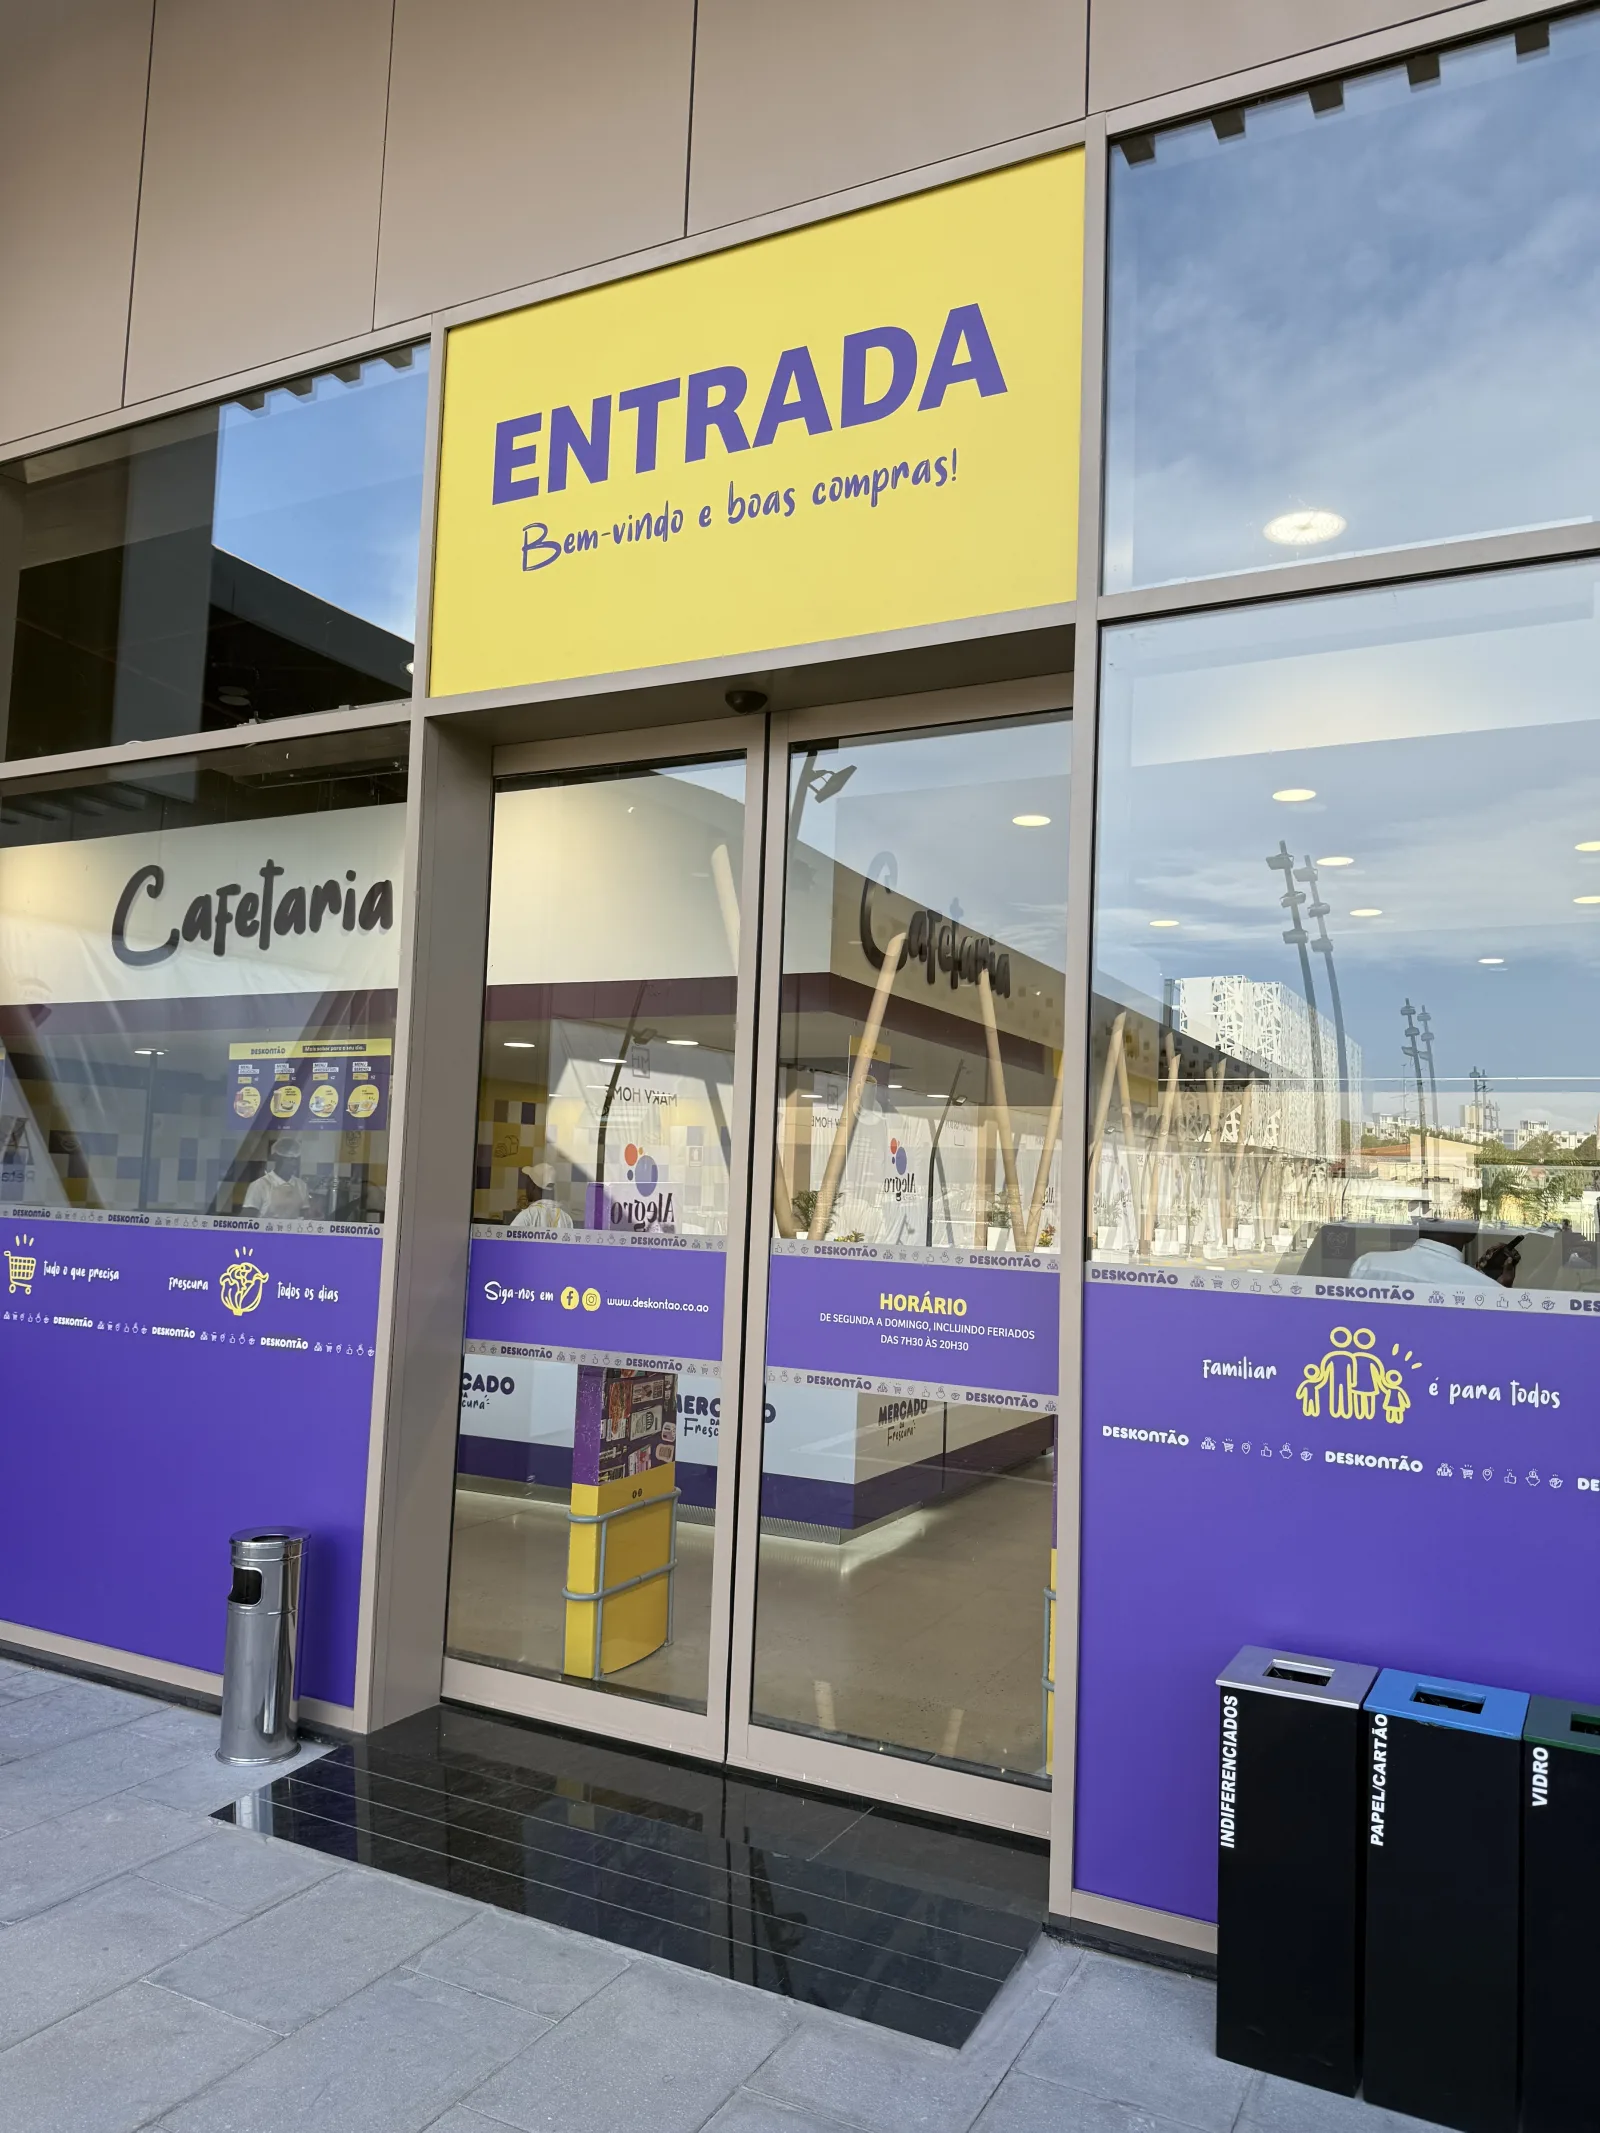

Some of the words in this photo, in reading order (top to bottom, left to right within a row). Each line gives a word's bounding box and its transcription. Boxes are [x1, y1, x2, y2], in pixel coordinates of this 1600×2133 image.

[492, 303, 1008, 505] ENTRADA
[522, 499, 684, 571] Bem-vindo
[698, 504, 712, 528] e
[727, 480, 796, 525] boas
[812, 447, 958, 508] compras!
[111, 859, 393, 966] Cafetaria
[860, 851, 1011, 998] Cafetaria
[12, 1208, 51, 1219] DESKONTÃO
[108, 1213, 150, 1225] DESKONTÃO
[213, 1218, 260, 1231] DESKONTÃO
[330, 1223, 382, 1236] DESKONTÃO
[506, 1229, 558, 1241] DESKONTÃO
[630, 1235, 687, 1248] DESKONTÃO
[813, 1245, 878, 1258] DESKONTÃO
[969, 1254, 1041, 1268] DESKONTÃO
[43, 1260, 60, 1276] Tudo
[62, 1266, 68, 1276] o
[70, 1266, 86, 1280] que
[88, 1266, 120, 1282] precisa
[1091, 1267, 1179, 1287] DESKONTÃO
[168, 1277, 209, 1292] Frescura
[277, 1281, 301, 1300] Todos
[304, 1287, 315, 1300] os
[318, 1284, 339, 1302] dias
[1315, 1284, 1415, 1302] DESKONTÃO
[484, 1280, 535, 1305] Siga-nos
[540, 1292, 554, 1302] em
[607, 1296, 709, 1313] www.deskontao.co.ao
[879, 1291, 968, 1317] HORÁRIO
[53, 1316, 93, 1329] DESKONTÃO
[819, 1313, 832, 1323] DE
[832, 1314, 875, 1327] SEGUNDA
[876, 1316, 883, 1327] A
[884, 1317, 932, 1332] DOMINGO,
[933, 1322, 985, 1336] INCLUINDO
[987, 1326, 1036, 1340] FERIADOS
[151, 1326, 196, 1340] DESKONTÃO
[260, 1336, 309, 1351] DESKONTÃO
[500, 1345, 553, 1359] DESKONTÃO
[880, 1334, 899, 1345] DAS
[900, 1336, 924, 1348] 7H30
[925, 1335, 938, 1349] ÀS
[939, 1339, 969, 1352] 20H30
[626, 1357, 683, 1372] DESKONTÃO
[1202, 1356, 1278, 1380] Familiar
[462, 1372, 515, 1395] CADO
[806, 1374, 872, 1391] DESKONTÃO
[965, 1391, 1038, 1409] DESKONTÃO
[1428, 1377, 1440, 1397] é
[1449, 1382, 1501, 1405] para
[1509, 1380, 1561, 1409] Todos
[461, 1399, 485, 1410] cura
[878, 1399, 928, 1426] MERCADO
[684, 1417, 720, 1438] Fresc
[1102, 1425, 1190, 1447] DESKONTÃO
[1324, 1450, 1424, 1474] DESKONTÃO
[1577, 1477, 1600, 1493] DE
[1220, 1694, 1239, 1849] INDIFERENCIADOS
[1370, 1713, 1389, 1847] PAPEL/CARTÃO
[1532, 1747, 1549, 1807] VIDRO
